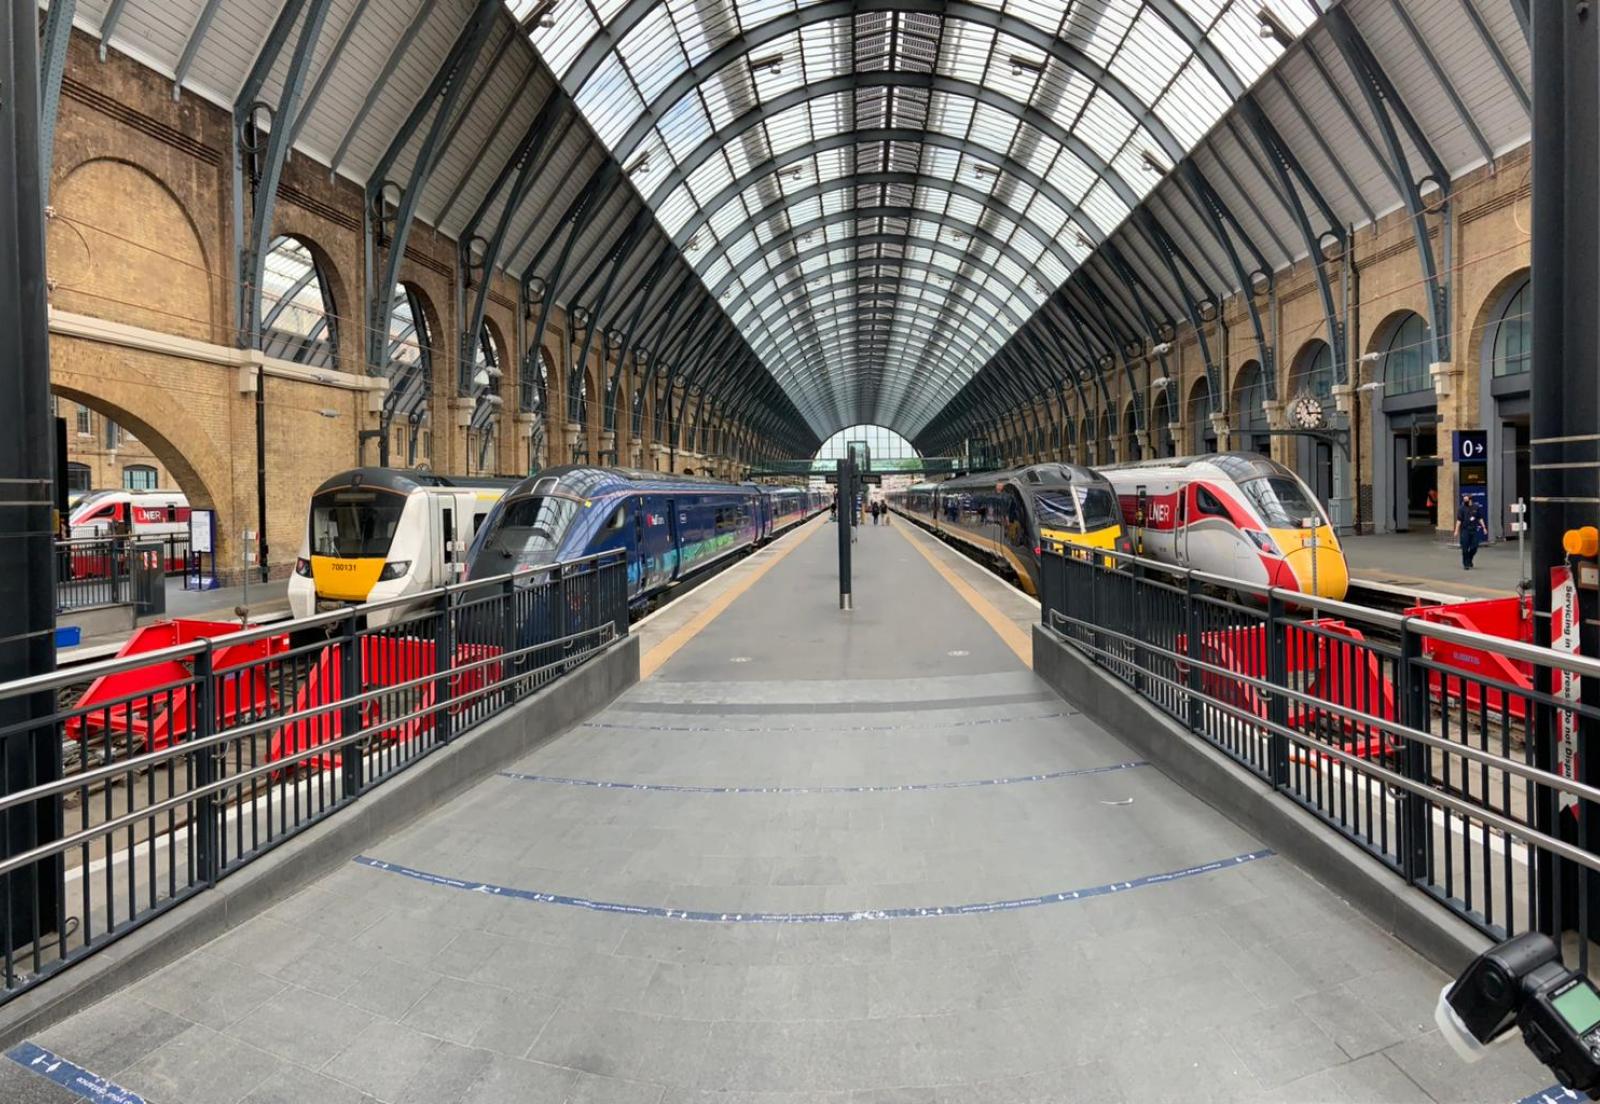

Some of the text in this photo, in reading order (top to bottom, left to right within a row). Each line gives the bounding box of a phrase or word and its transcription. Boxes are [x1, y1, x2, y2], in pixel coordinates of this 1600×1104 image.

[1463, 440, 1473, 457] 0
[138, 510, 161, 521] LNER
[1149, 502, 1170, 522] LNER
[331, 563, 357, 572] 700131
[1564, 585, 1573, 636] Servicing
[1565, 638, 1572, 648] in
[1565, 726, 1573, 745] not
